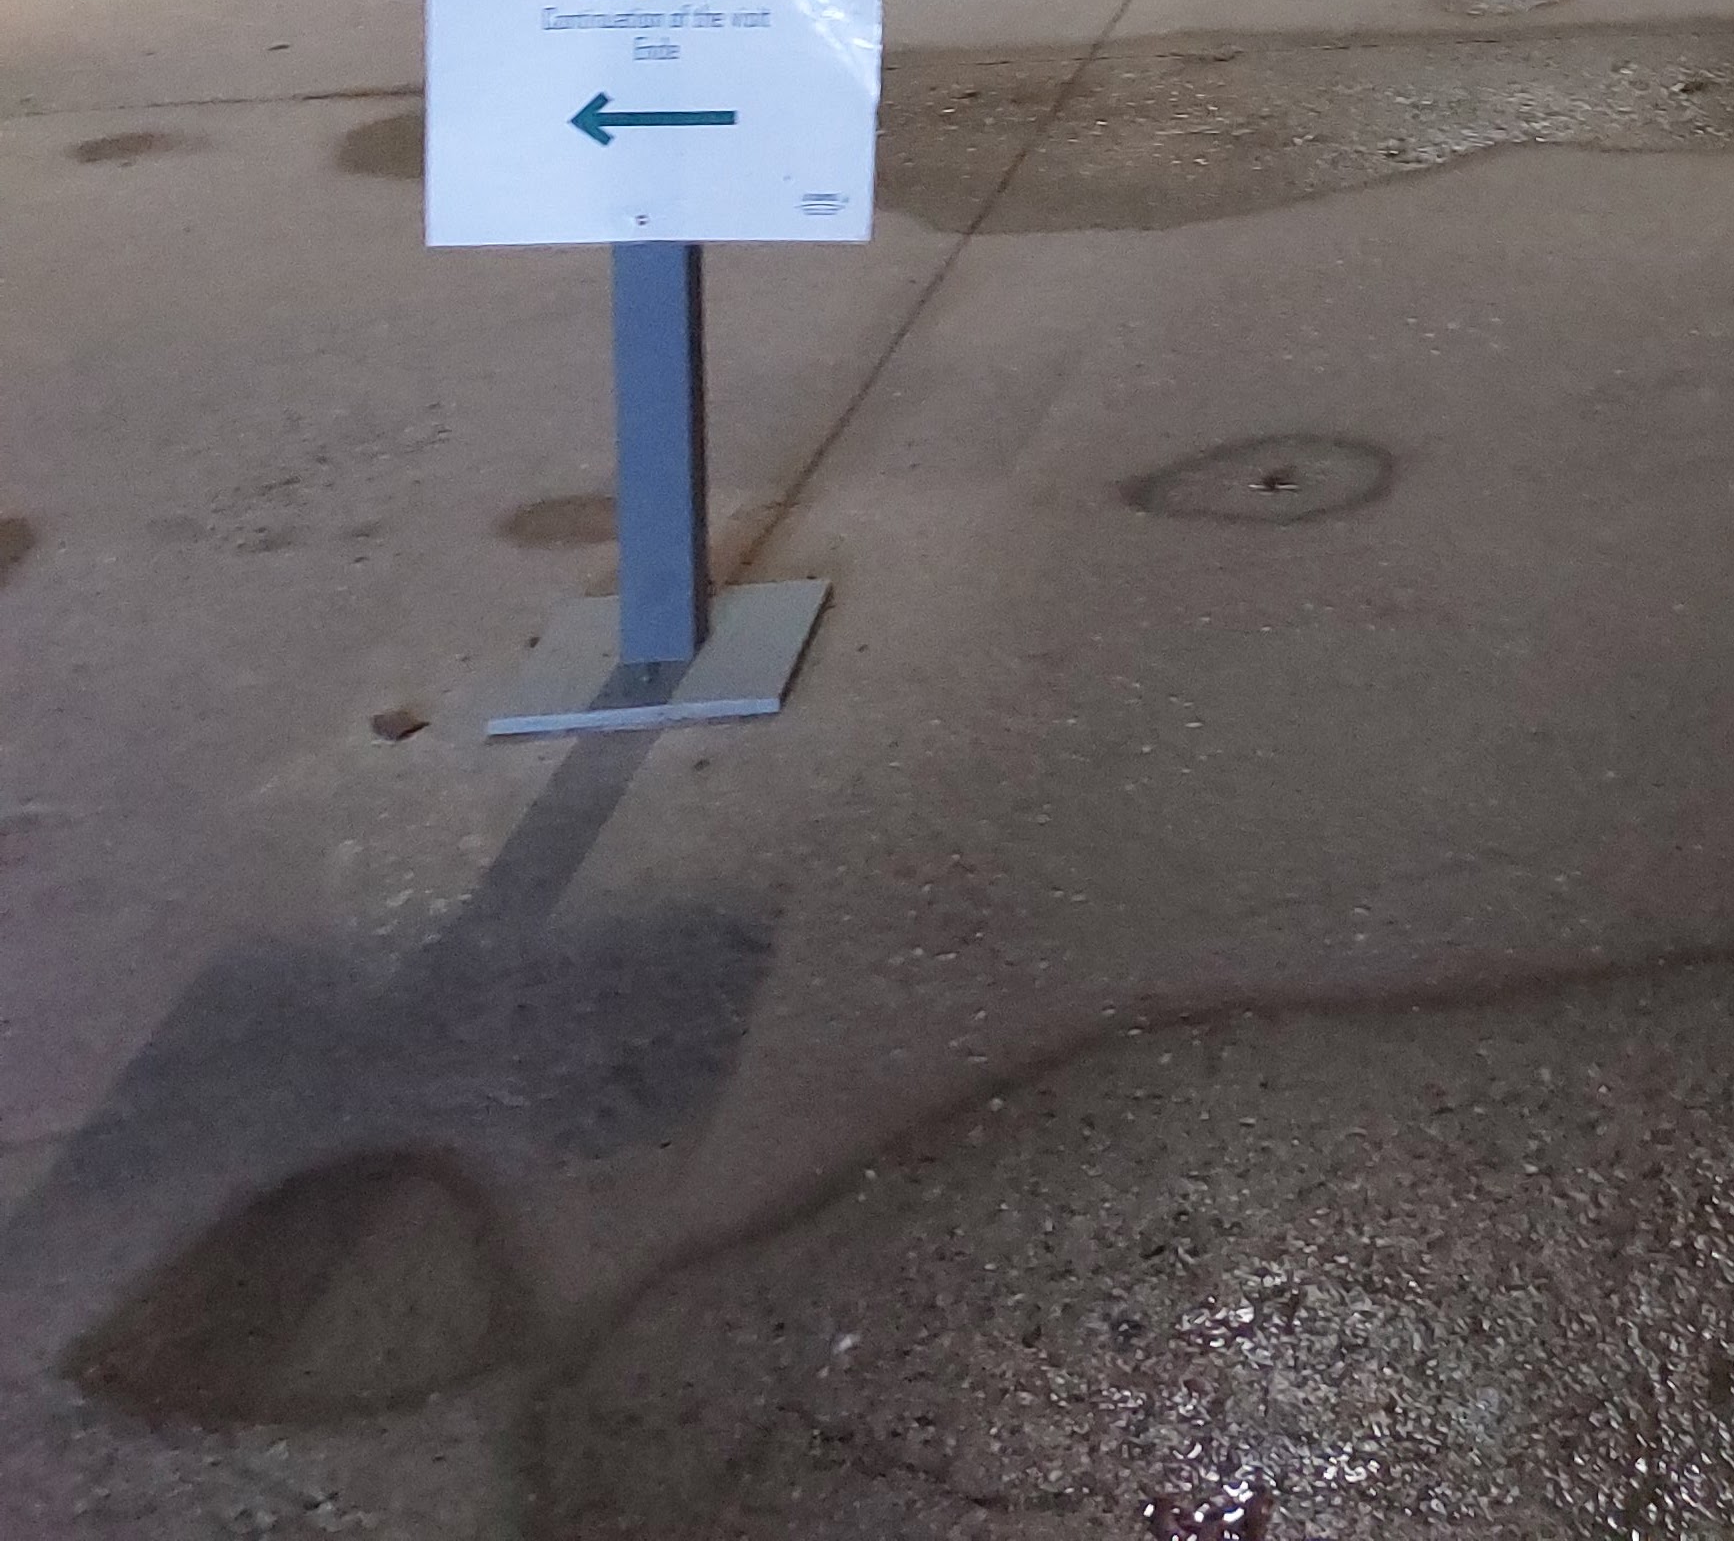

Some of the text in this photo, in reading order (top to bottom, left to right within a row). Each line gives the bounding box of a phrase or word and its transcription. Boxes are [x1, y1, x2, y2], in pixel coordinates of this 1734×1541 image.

[541, 6, 664, 30] Continuation
[668, 3, 690, 28] of
[691, 4, 725, 28] the
